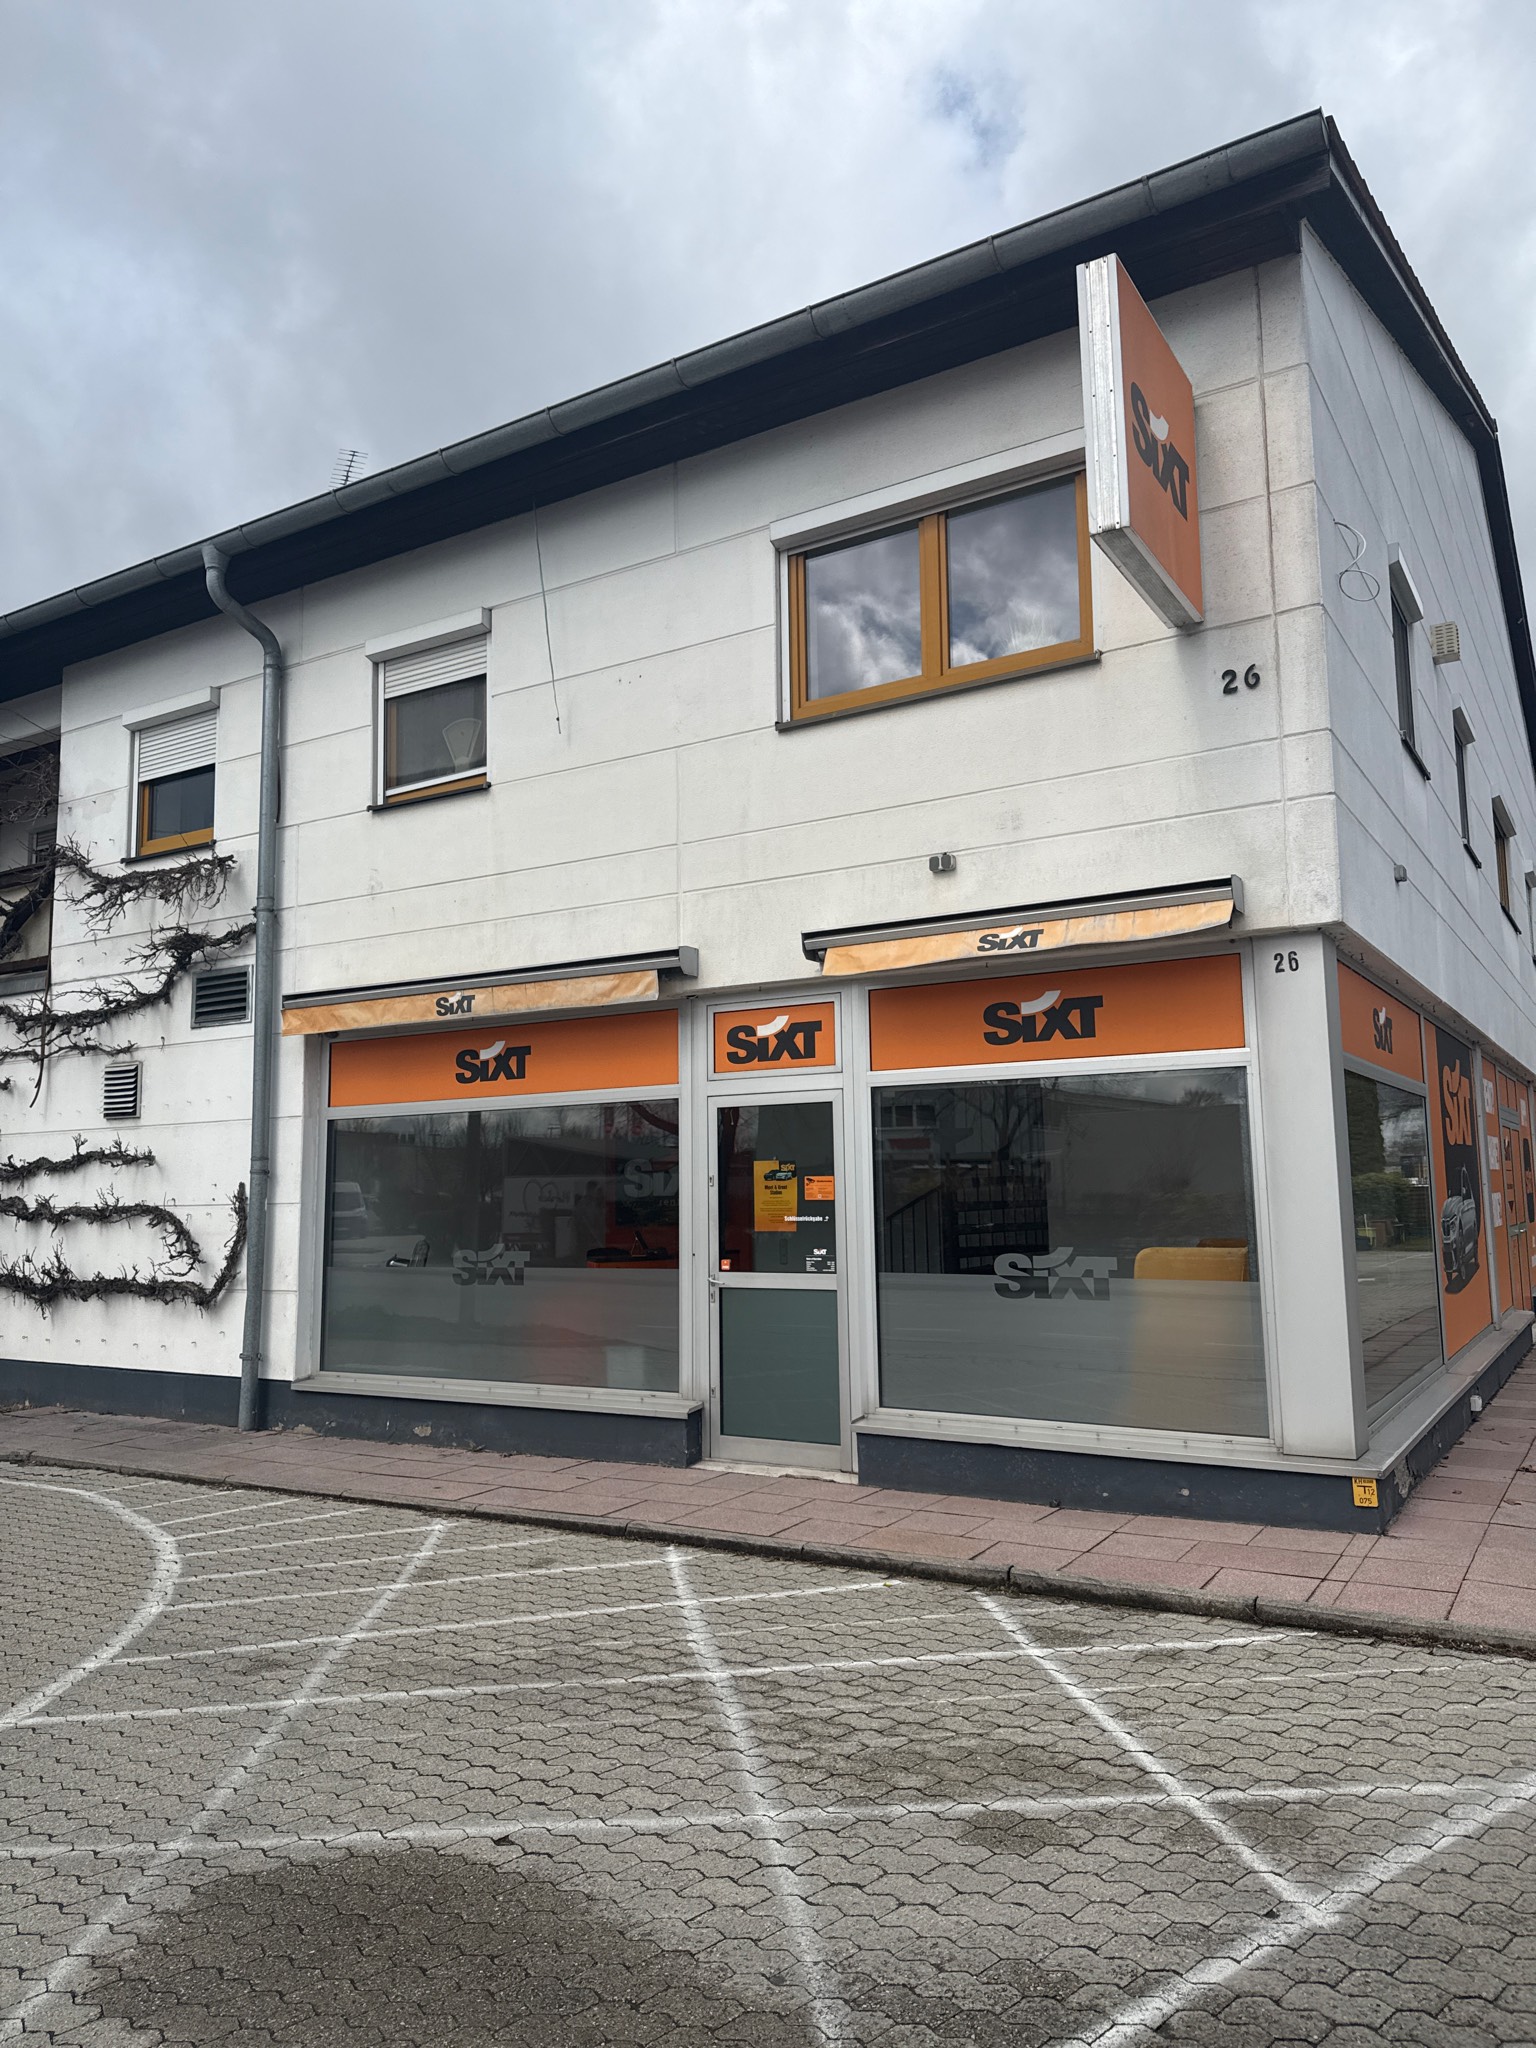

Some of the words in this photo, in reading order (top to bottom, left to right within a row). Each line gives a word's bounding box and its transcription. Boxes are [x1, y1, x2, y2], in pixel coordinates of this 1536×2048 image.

[1130, 381, 1190, 522] SIXT
[1221, 663, 1261, 695] 26
[976, 926, 1045, 952] SIXT
[1273, 950, 1299, 974] 26
[435, 990, 476, 1017] SIXT
[983, 989, 1104, 1046] SIXT
[726, 1014, 823, 1065] SIXT
[455, 1039, 532, 1084] SIXT
